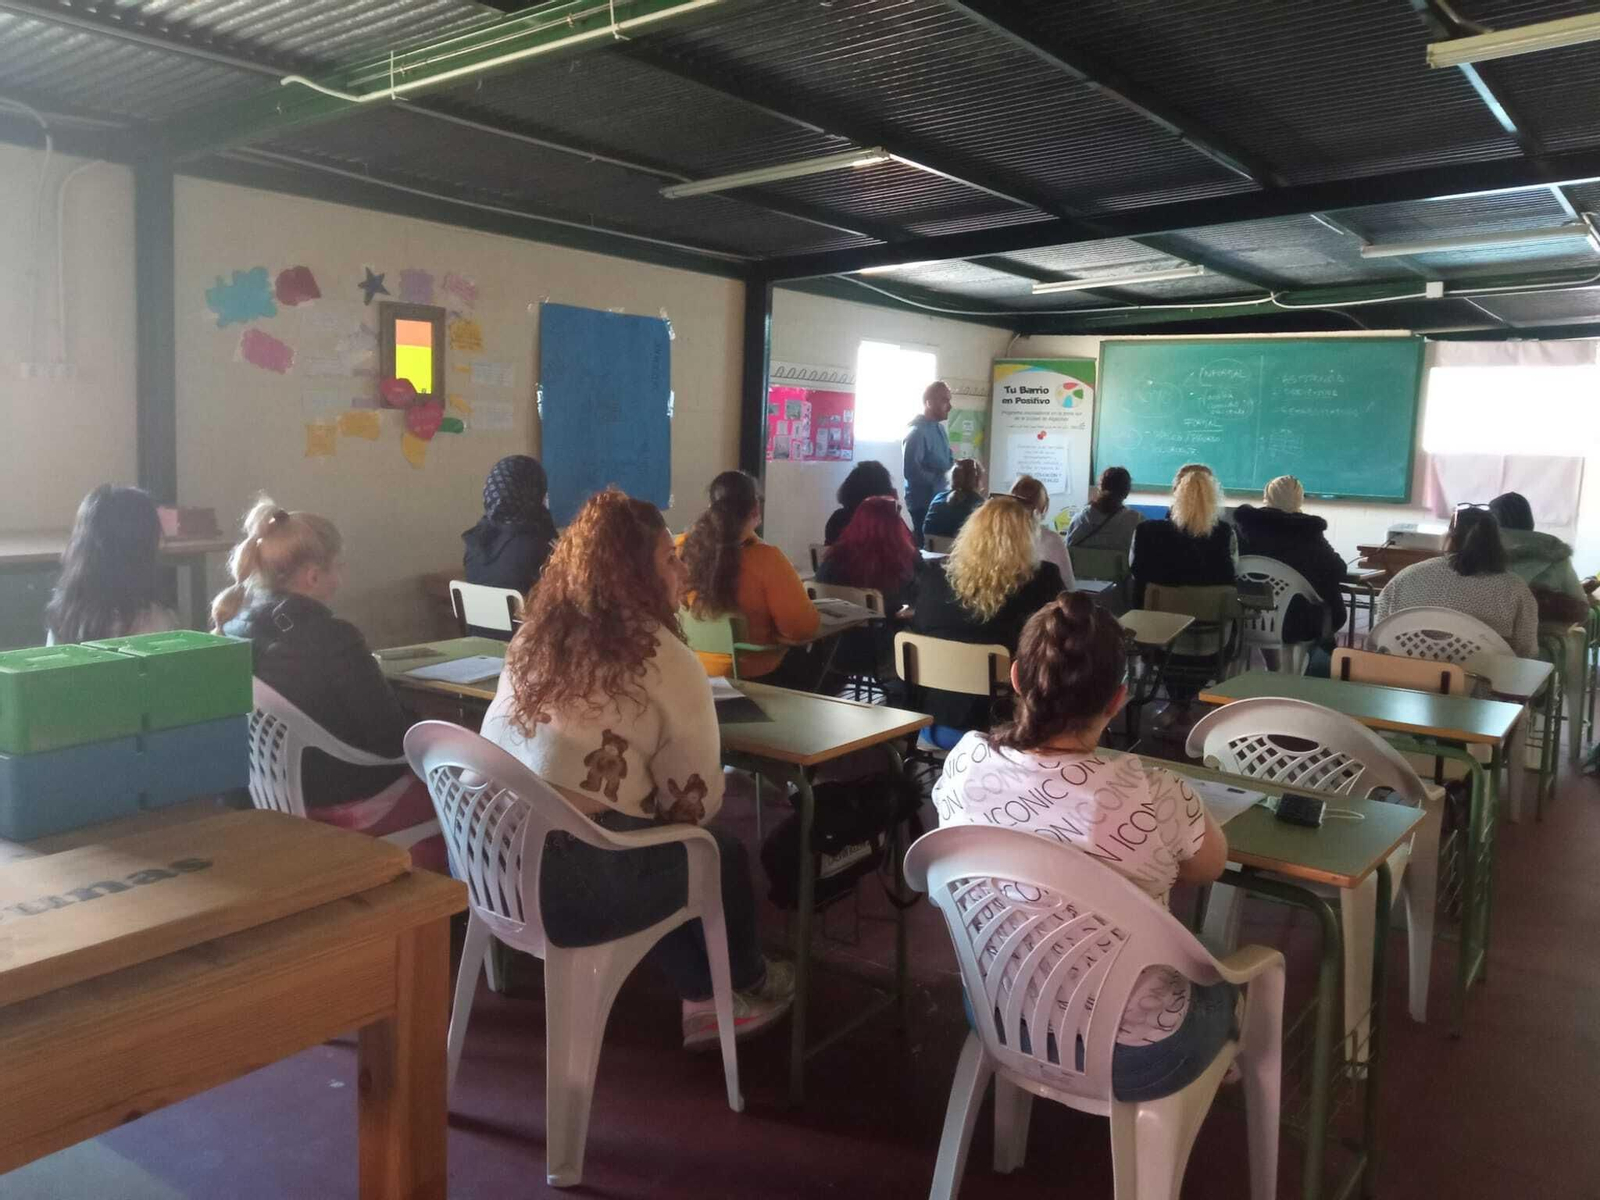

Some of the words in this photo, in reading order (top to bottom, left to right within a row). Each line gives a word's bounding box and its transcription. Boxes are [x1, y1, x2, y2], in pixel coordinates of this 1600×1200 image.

[1004, 386, 1017, 394] Tu
[1019, 385, 1049, 395] Barrio
[1015, 397, 1050, 405] Positivo
[0, 857, 213, 922] unas
